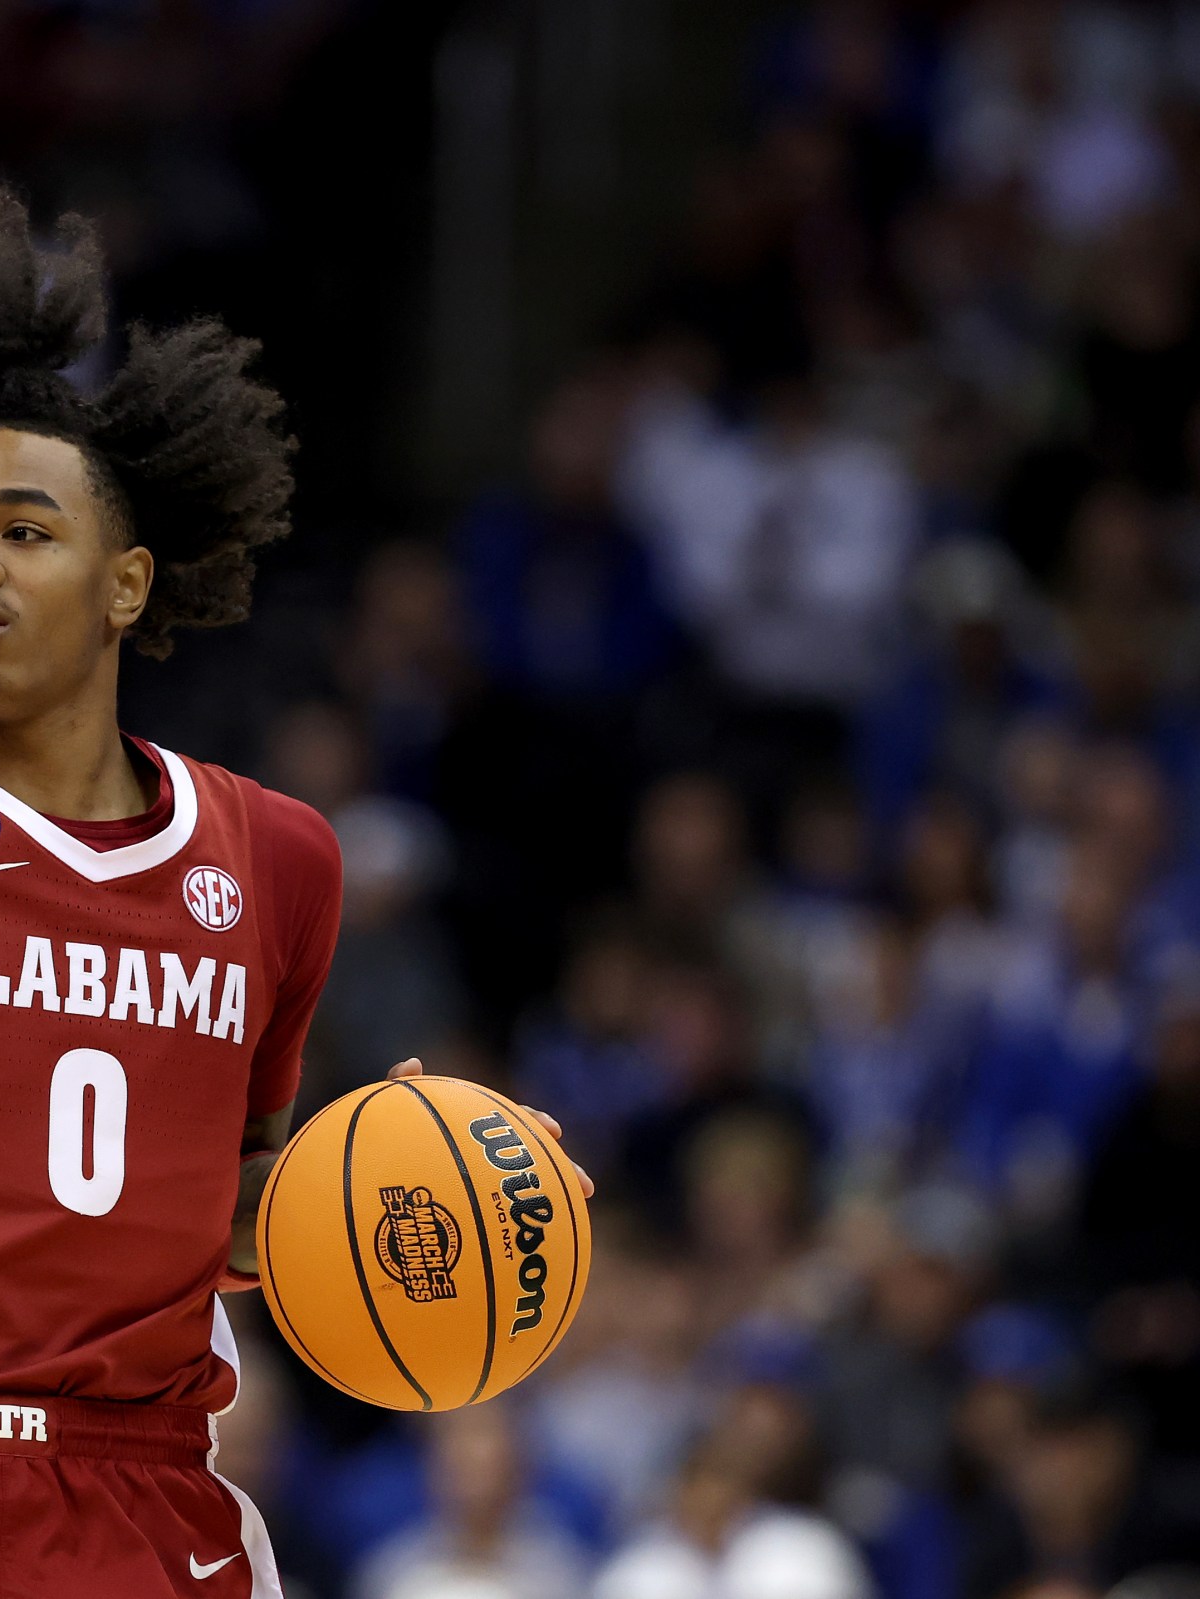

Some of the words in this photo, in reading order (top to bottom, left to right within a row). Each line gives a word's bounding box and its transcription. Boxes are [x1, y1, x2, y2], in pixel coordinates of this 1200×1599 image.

[188, 870, 237, 925] SEC
[48, 1048, 128, 1217] 0
[380, 1237, 388, 1257] ELITE
[413, 1207, 444, 1268] MARCH
[442, 1217, 456, 1239] SWEET
[469, 1111, 553, 1336] Wilson
[490, 1192, 507, 1223] EVO
[501, 1227, 513, 1261] NXT
[396, 1218, 432, 1301] MADNESS
